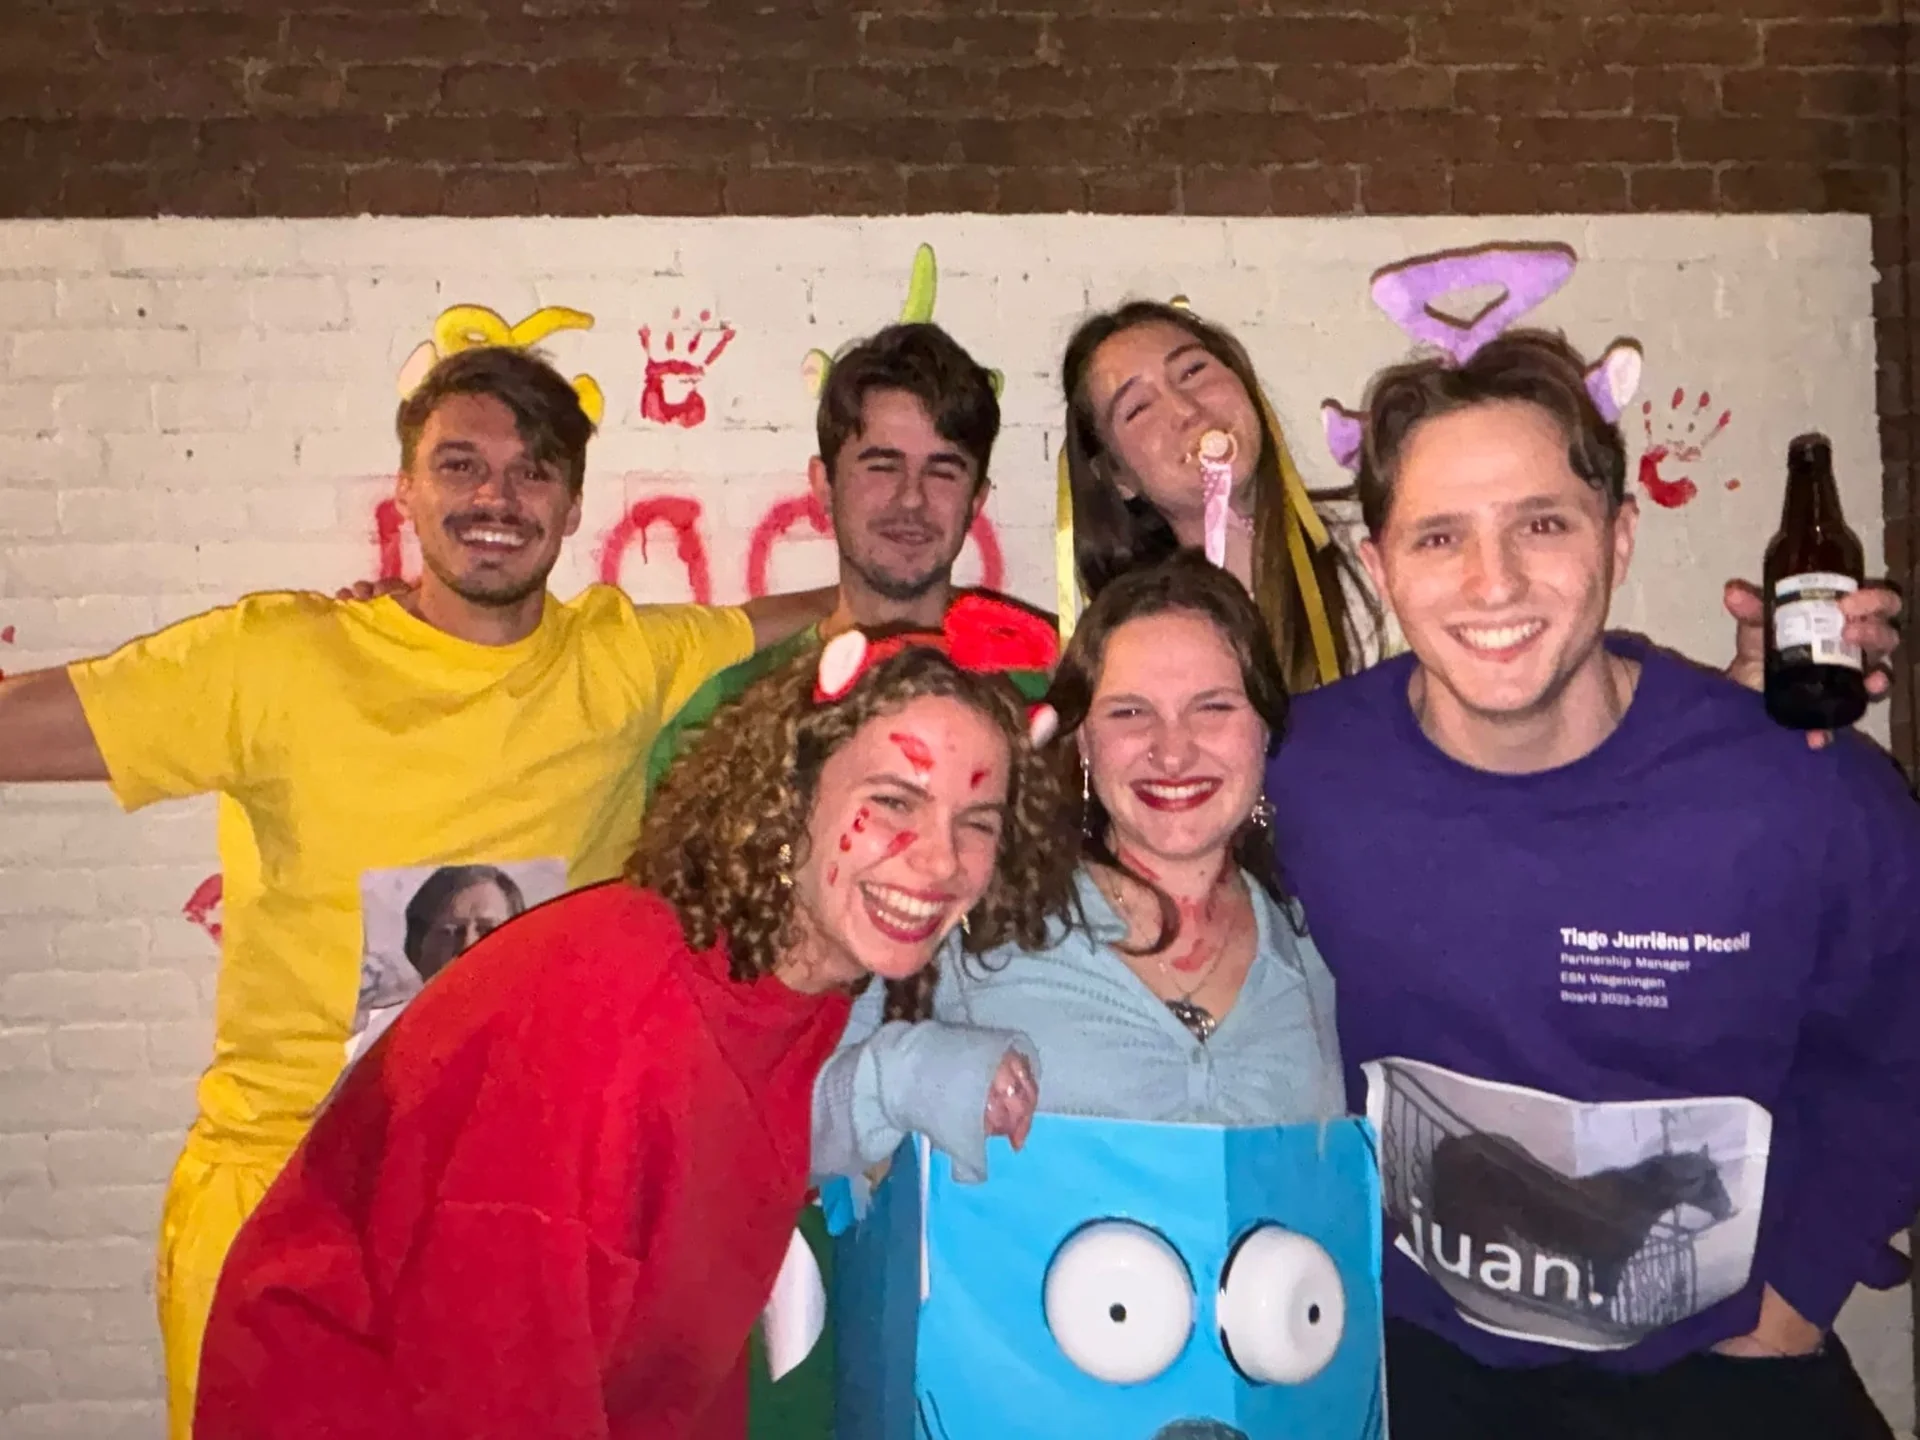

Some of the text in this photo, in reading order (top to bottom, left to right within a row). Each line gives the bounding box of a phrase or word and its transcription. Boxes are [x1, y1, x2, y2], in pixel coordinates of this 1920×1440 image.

[1560, 927, 1608, 951] Tiago
[1694, 931, 1750, 953] Piccoli
[1560, 952, 1690, 972] Partnership Manager
[1560, 971, 1666, 990] ESN Wageningen
[1560, 990, 1597, 1004] Board
